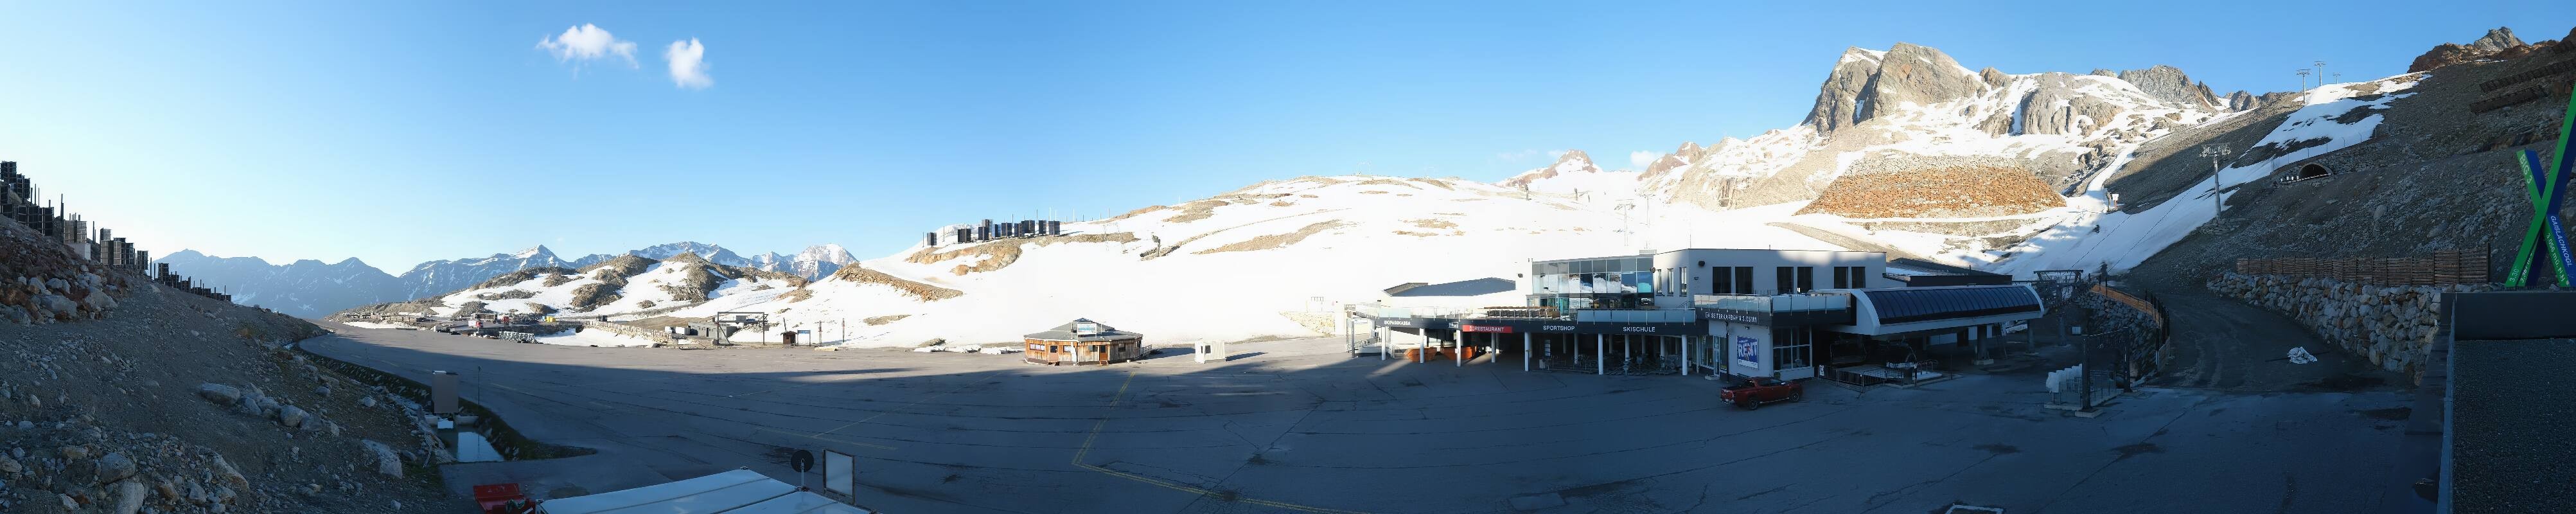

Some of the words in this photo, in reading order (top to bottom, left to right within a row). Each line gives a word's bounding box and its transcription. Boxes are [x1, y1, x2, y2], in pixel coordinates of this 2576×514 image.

[2519, 154, 2530, 175] BIG
[2527, 175, 2532, 184] 3
[2550, 215, 2573, 267] GAISLACHKOGL
[1738, 342, 1758, 357] RENT
